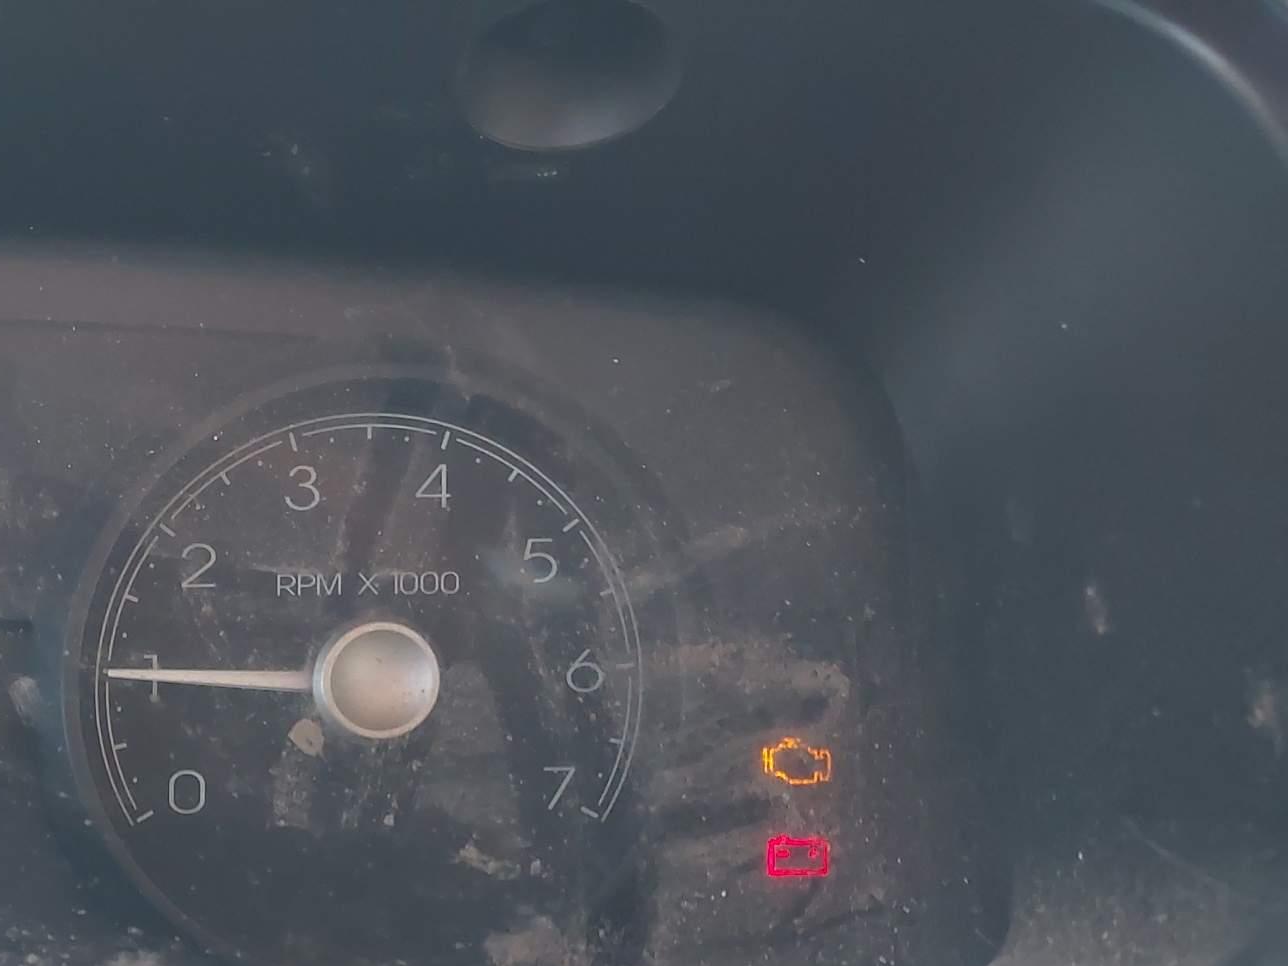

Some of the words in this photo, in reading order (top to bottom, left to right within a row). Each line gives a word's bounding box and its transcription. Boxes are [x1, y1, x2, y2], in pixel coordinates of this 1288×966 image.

[285, 465, 321, 510] 3
[415, 463, 451, 508] 4
[181, 543, 216, 588] 2
[522, 538, 558, 583] 5
[276, 574, 341, 596] RPM
[358, 572, 379, 594] X
[392, 571, 460, 595] 1000
[566, 649, 604, 692] 6
[168, 770, 206, 814] 0
[543, 766, 577, 810] 7
